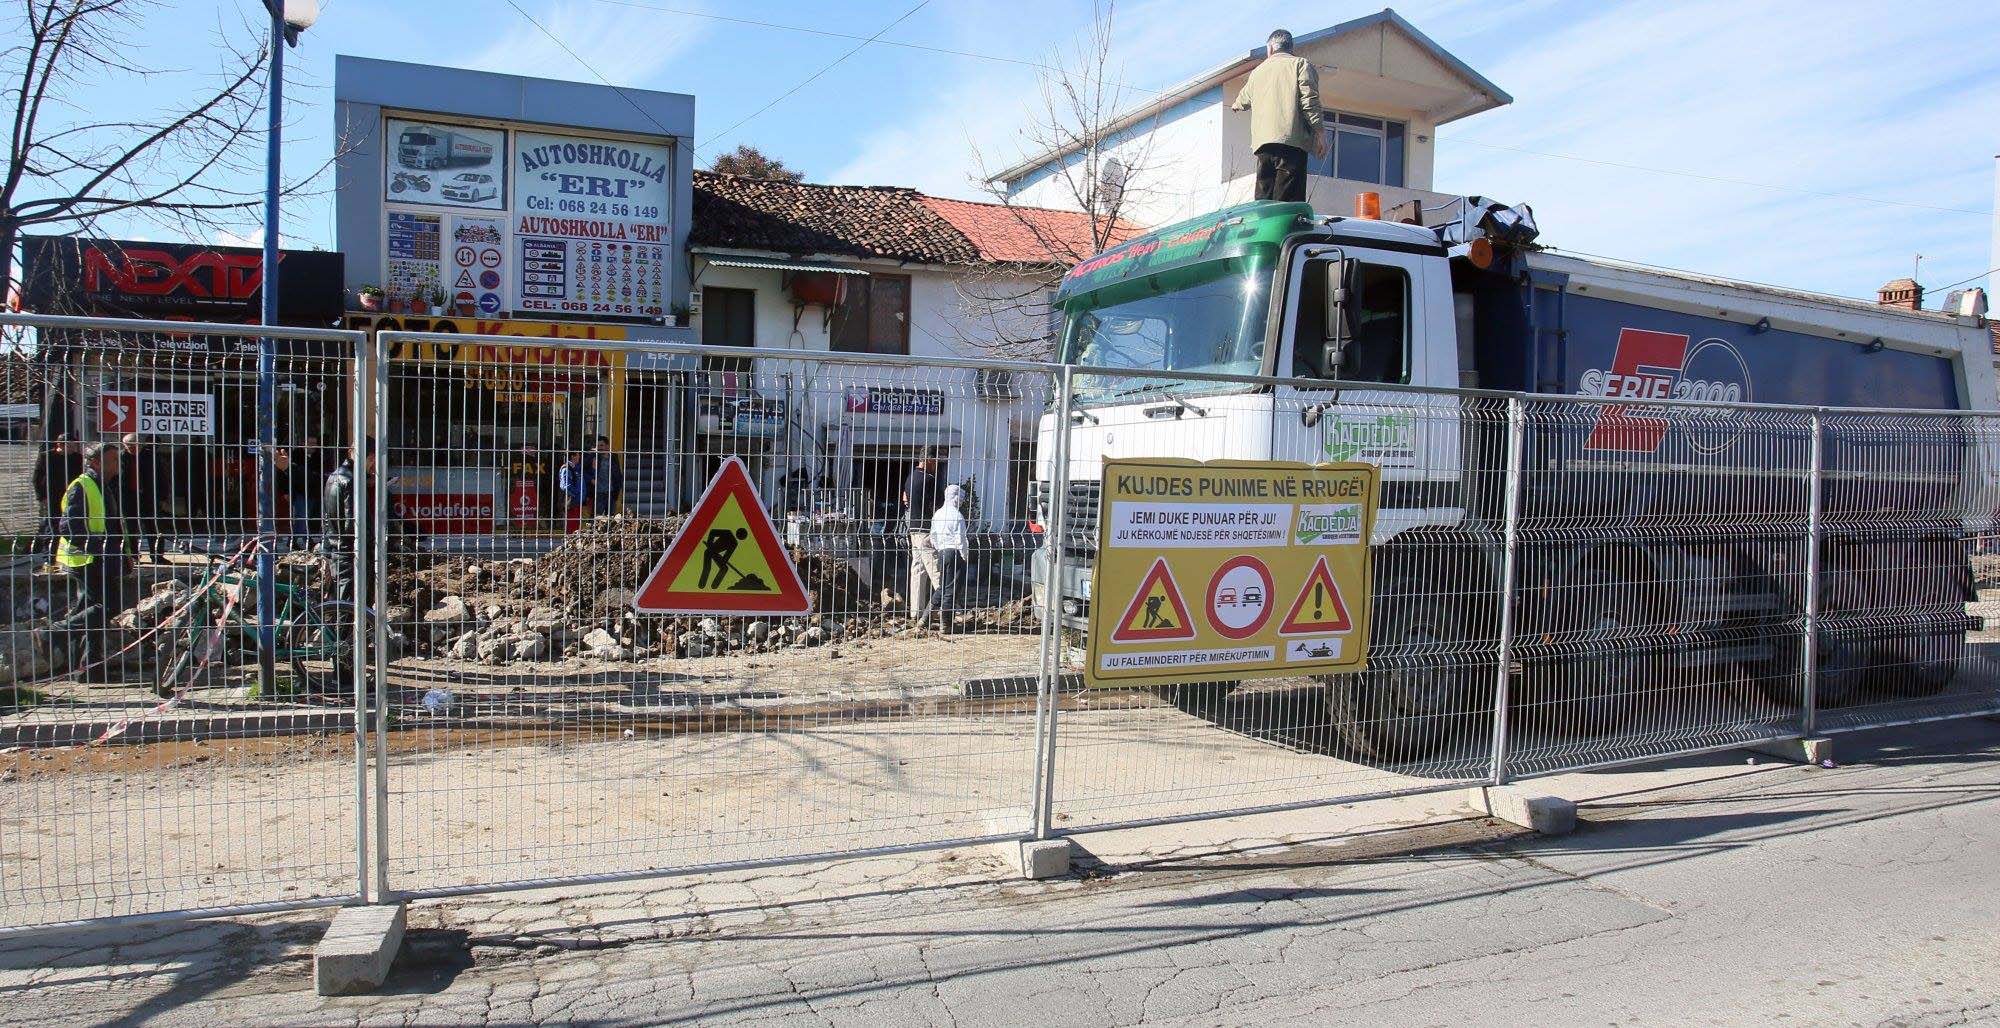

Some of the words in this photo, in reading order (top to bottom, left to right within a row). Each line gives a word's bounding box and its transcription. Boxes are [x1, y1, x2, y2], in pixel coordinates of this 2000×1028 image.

[522, 143, 666, 183] AUTOSHKOLLA
[541, 172, 645, 199] “ERI”
[527, 195, 554, 210] Cel:
[559, 199, 585, 213] 068
[590, 201, 607, 214] 24
[612, 204, 628, 216] 56
[634, 206, 658, 219] 149
[519, 216, 627, 239] AUTOSHKOLLA
[630, 224, 667, 242] “ERI”
[158, 296, 192, 305] LEVEL
[522, 300, 556, 310] CEL:
[561, 301, 588, 312] 068
[592, 303, 610, 312] 24
[615, 304, 632, 314] 56
[637, 305, 662, 315] 149
[144, 401, 207, 415] PARTNER
[142, 418, 209, 432] DGITALB
[512, 462, 546, 474] FAX
[1117, 475, 1193, 496] KUJDES
[1199, 477, 1268, 497] PUNIME
[1273, 476, 1297, 497] NË
[1302, 476, 1364, 498] RRUGË!
[410, 502, 491, 517] vodafone
[1130, 512, 1156, 524] JEMI
[1158, 512, 1189, 524] DUKE
[1192, 512, 1236, 525] PUNUAR
[1238, 511, 1258, 525] PËR
[1260, 513, 1276, 525] JU!
[1117, 530, 1129, 540] JU
[1131, 528, 1178, 540] KËRKOJMË
[1180, 529, 1212, 540] NDJESË
[1214, 529, 1230, 540] PËR
[1232, 529, 1281, 540] SHQETËSIMIN
[1107, 657, 1119, 667] JU
[1121, 655, 1187, 667] FALEMINDERIT
[1189, 652, 1207, 663] PËR
[1209, 650, 1270, 662] MIRËKUPTIMIN
